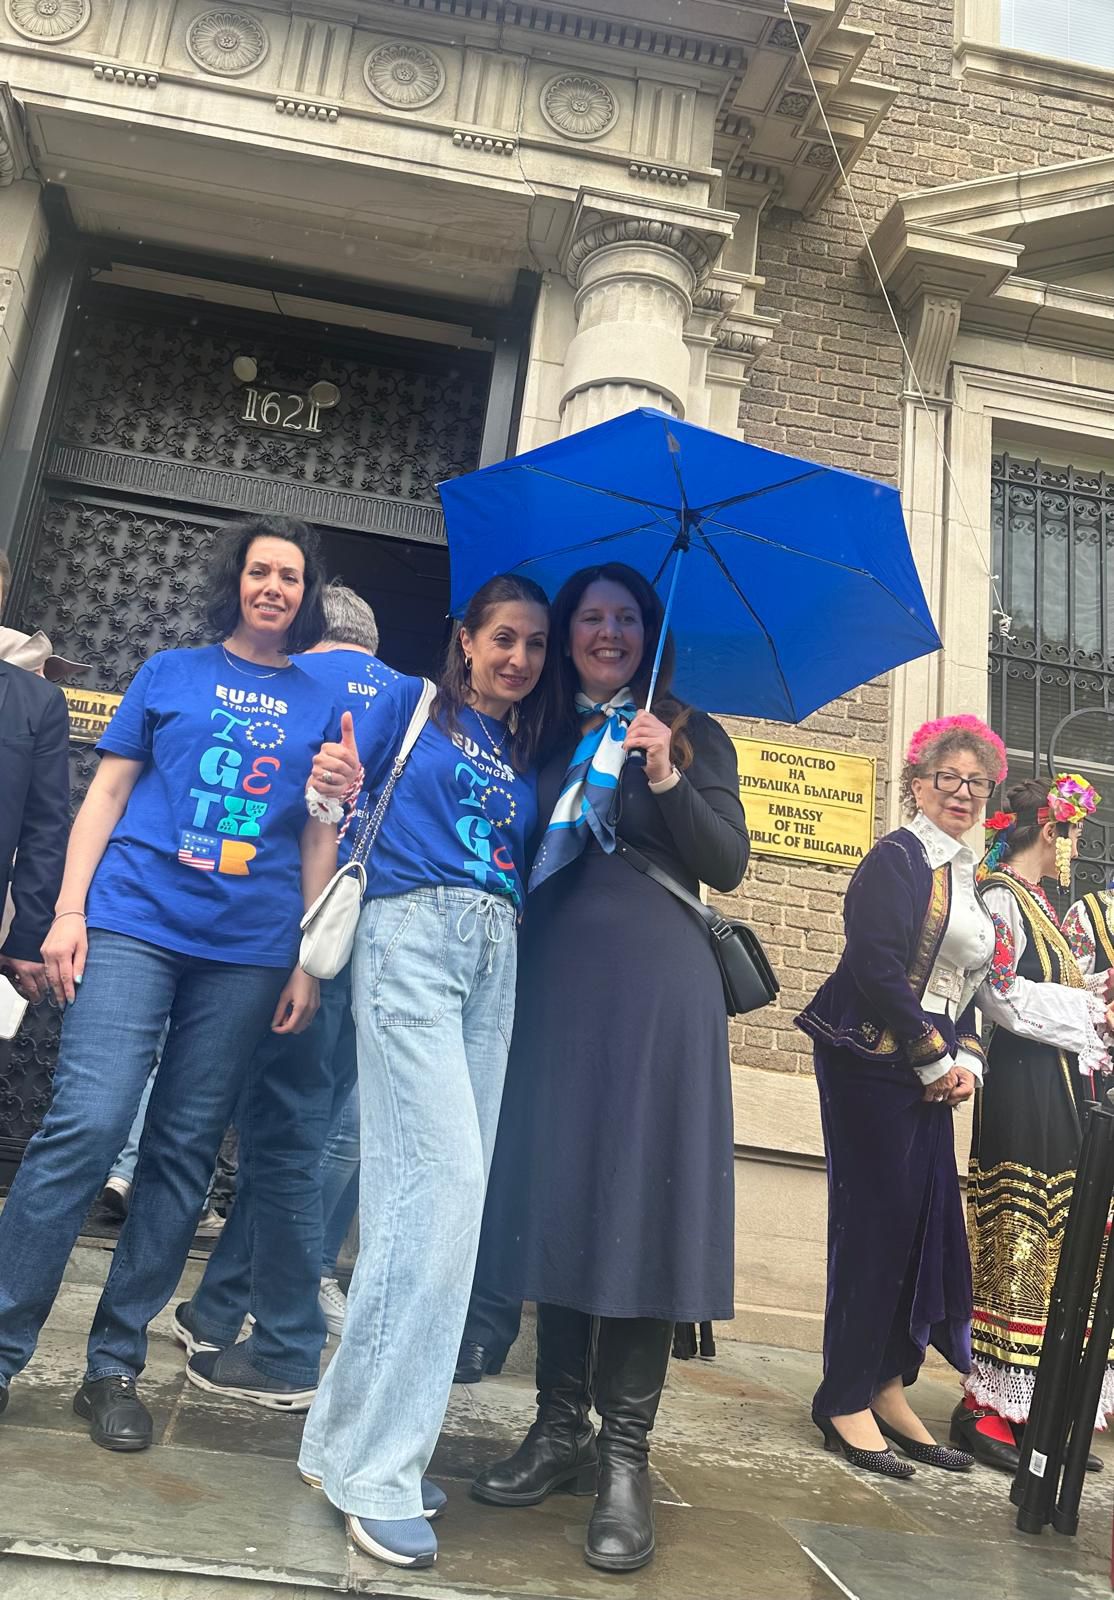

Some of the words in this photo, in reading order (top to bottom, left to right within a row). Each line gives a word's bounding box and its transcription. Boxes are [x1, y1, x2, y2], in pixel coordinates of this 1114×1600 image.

[242, 388, 322, 432] 1621
[67, 698, 106, 717] SULAR
[215, 684, 288, 715] EU&US
[760, 750, 836, 772] ПОСОЛСТВО
[788, 768, 806, 781] НА
[804, 785, 863, 804] БЪЛГАРИЯ
[768, 803, 823, 822] EMBASSY
[774, 819, 791, 832] OF
[793, 822, 816, 836] THE
[784, 835, 801, 848] OF
[803, 837, 864, 858] BULGARIA
